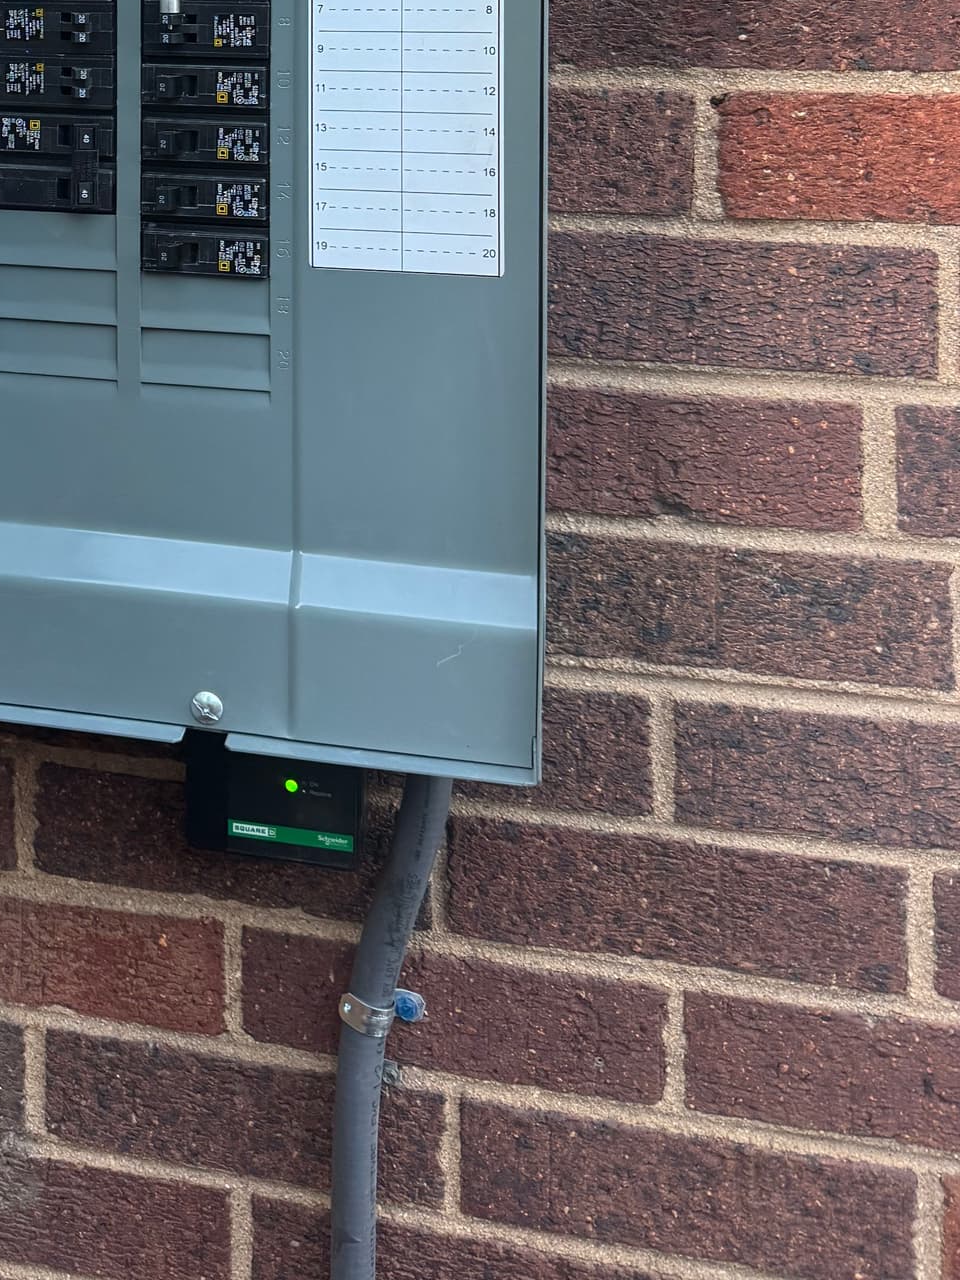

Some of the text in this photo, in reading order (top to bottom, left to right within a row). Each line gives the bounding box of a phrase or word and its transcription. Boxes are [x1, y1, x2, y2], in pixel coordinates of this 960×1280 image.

[318, 5, 324, 13] 7
[486, 6, 492, 14] 8
[79, 14, 85, 23] 20
[162, 15, 168, 24] 20
[79, 33, 86, 42] 20
[162, 34, 168, 44] 20
[318, 45, 324, 53] 9
[484, 47, 495, 55] 10
[80, 69, 87, 79] 20
[160, 83, 166, 92] 20
[484, 87, 496, 95] 12
[79, 88, 86, 98] 20
[316, 123, 327, 132] 13
[484, 128, 495, 136] 14
[83, 134, 89, 143] 40
[160, 140, 166, 149] 20
[316, 163, 327, 171] 15
[484, 168, 495, 176] 16
[81, 190, 88, 198] 40
[159, 195, 165, 204] 20
[316, 202, 327, 210] 17
[484, 209, 496, 218] 18
[316, 242, 327, 250] 19
[161, 252, 167, 261] 20
[483, 249, 496, 258] 20
[235, 825, 266, 834] SQUARE
